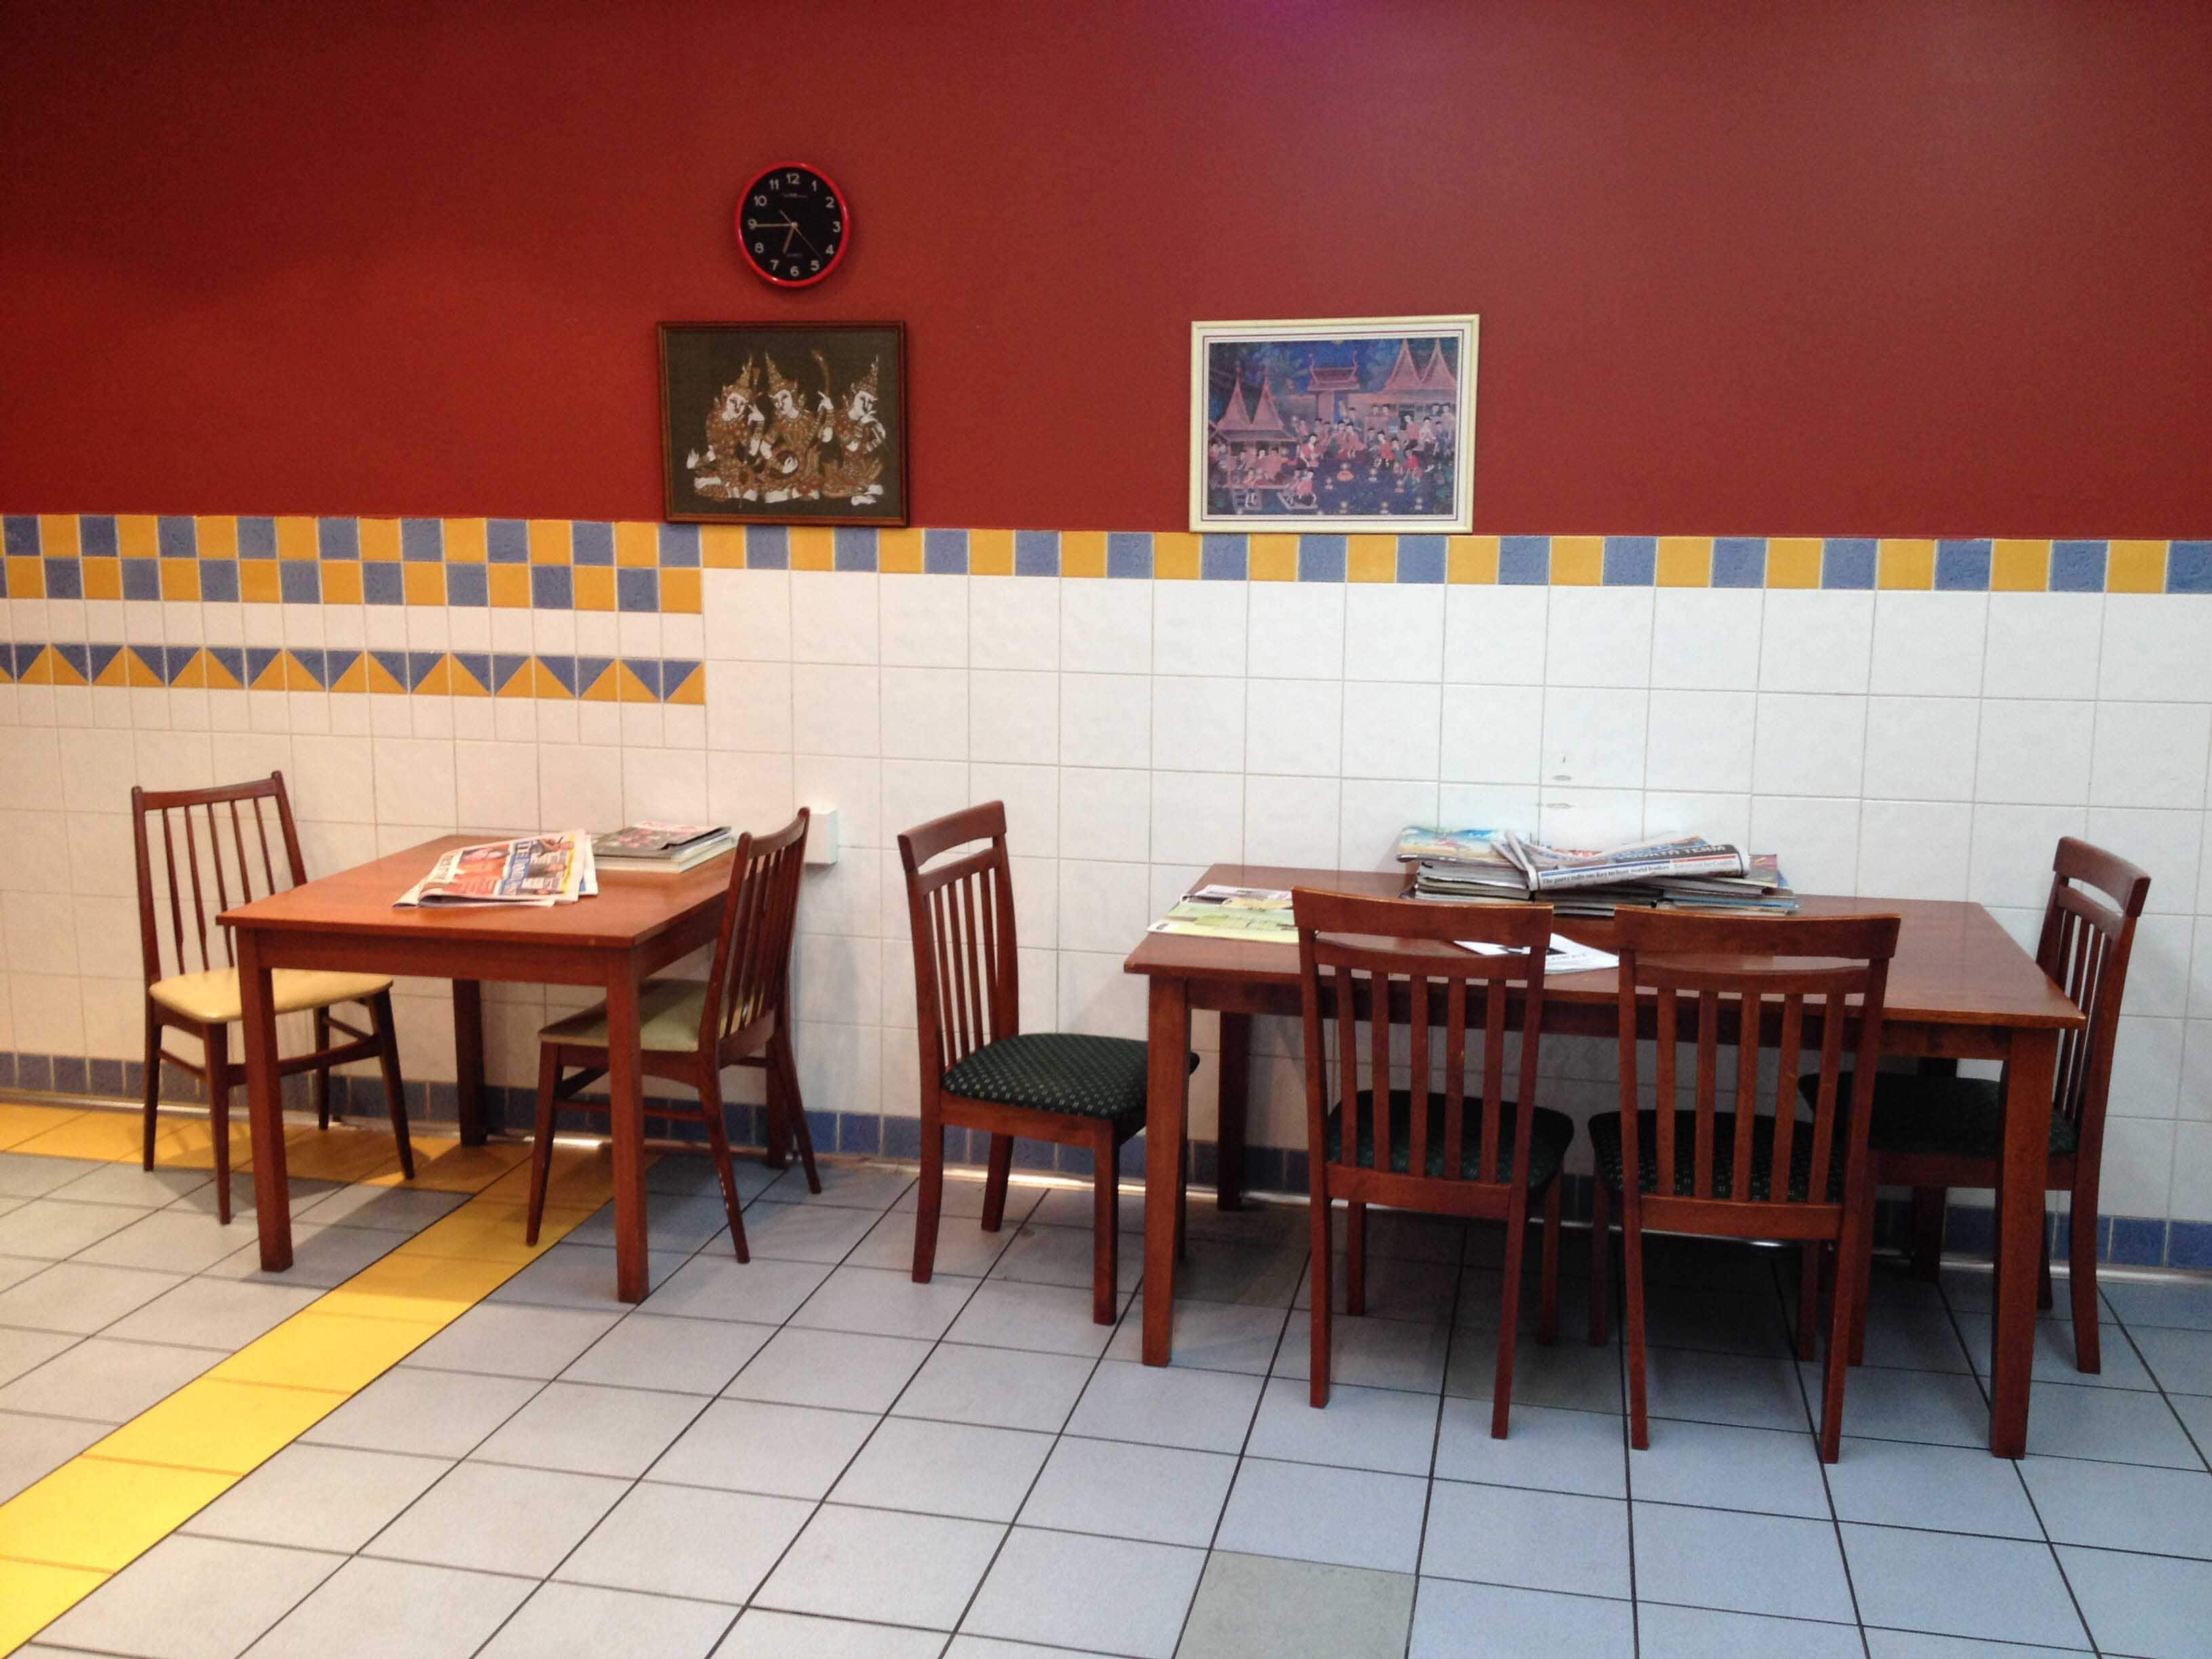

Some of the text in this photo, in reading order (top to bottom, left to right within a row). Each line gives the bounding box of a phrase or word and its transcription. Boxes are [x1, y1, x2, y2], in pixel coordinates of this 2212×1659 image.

[769, 178, 779, 190] 11
[786, 173, 800, 185] 12
[811, 179, 817, 192] 1
[754, 194, 767, 207] 10
[825, 196, 835, 208] 2
[747, 218, 758, 230] 9
[832, 221, 841, 233] 3
[754, 242, 764, 254] 8
[825, 244, 834, 255] 4
[770, 259, 779, 271] 7
[790, 265, 800, 277] 6
[811, 260, 820, 271] 5
